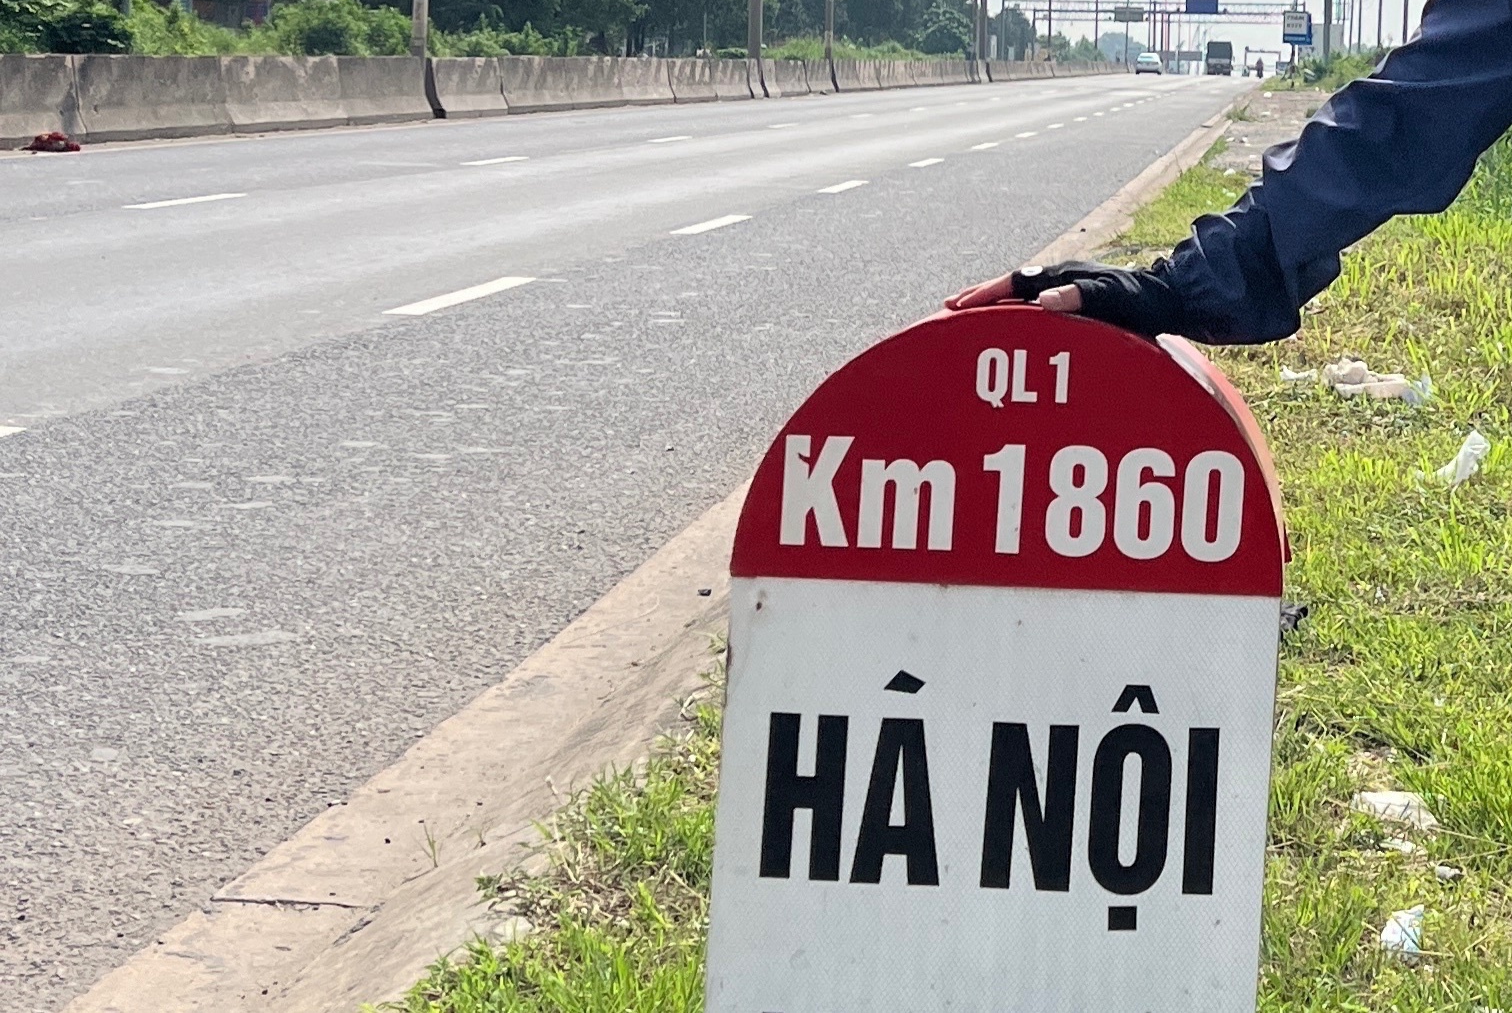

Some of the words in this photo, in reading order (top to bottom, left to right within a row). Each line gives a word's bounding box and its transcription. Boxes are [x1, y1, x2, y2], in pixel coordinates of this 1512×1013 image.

[779, 434, 957, 552] Km
[983, 443, 1246, 564] 1860
[979, 684, 1220, 931] NỘI
